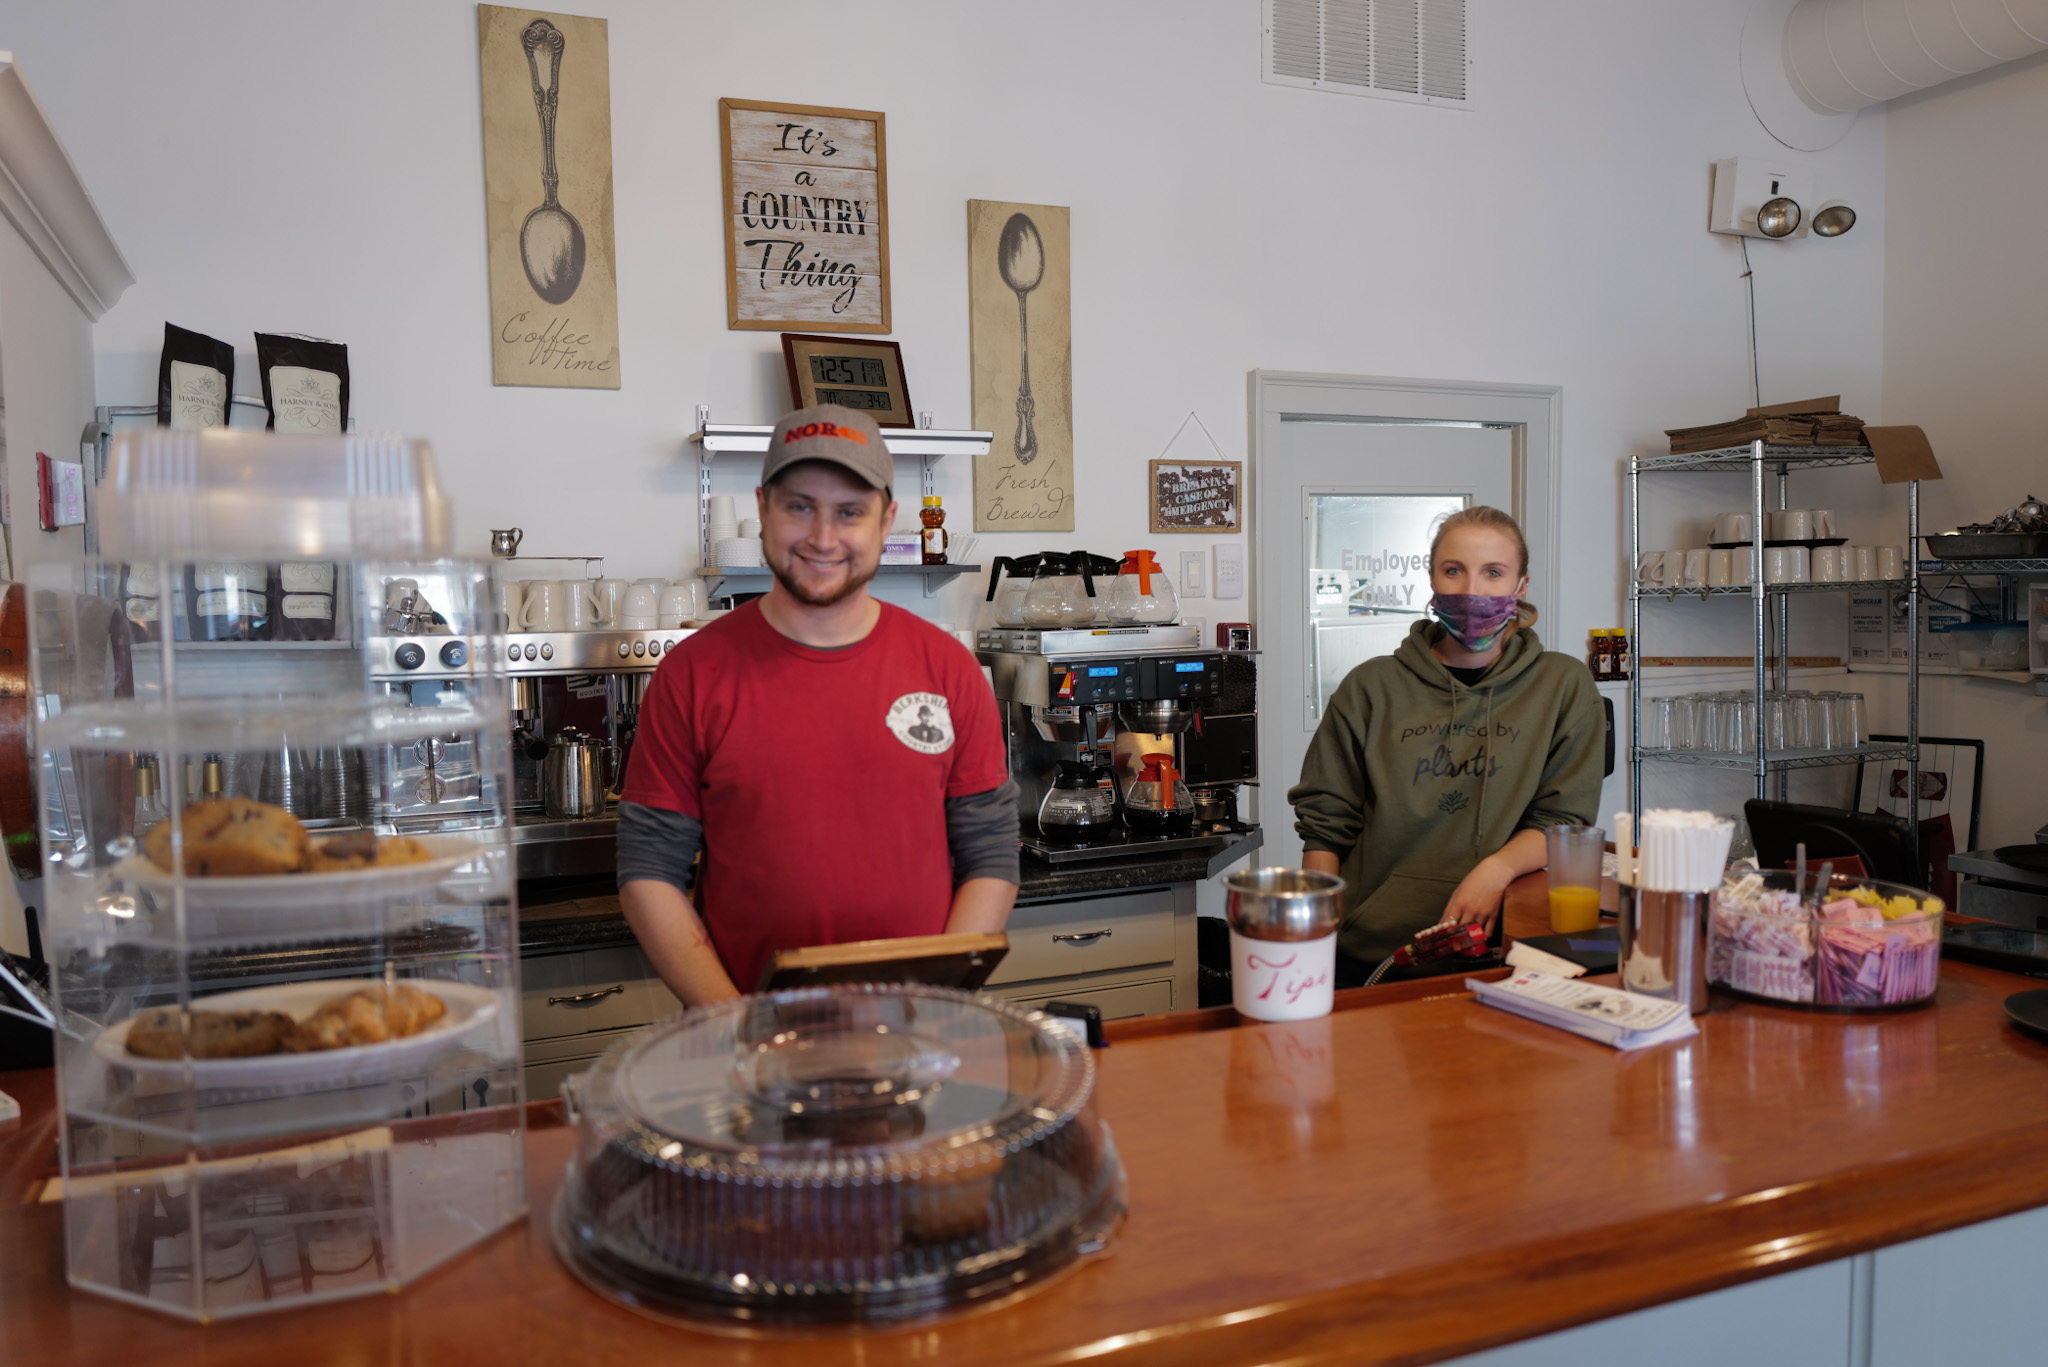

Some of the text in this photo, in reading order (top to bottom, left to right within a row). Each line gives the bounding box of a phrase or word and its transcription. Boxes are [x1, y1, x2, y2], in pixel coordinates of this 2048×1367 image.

[773, 123, 839, 157] It's
[794, 171, 817, 187] a
[742, 191, 870, 236] COUNTRY
[743, 239, 863, 314] Thing
[501, 310, 592, 365] Coffee
[820, 358, 867, 384] 12:51
[178, 394, 210, 407] HARNEY
[280, 398, 314, 407] HARNEY
[995, 458, 1057, 491] Fresh
[1171, 478, 1210, 494] BREAK
[986, 486, 1069, 521] Brewed
[1162, 499, 1229, 517] EMERGENCY
[1175, 490, 1203, 505] CASE
[1361, 583, 1415, 607] ONLY
[1496, 721, 1521, 744] by
[1412, 744, 1504, 786] plants
[1247, 951, 1328, 1005] Tips
